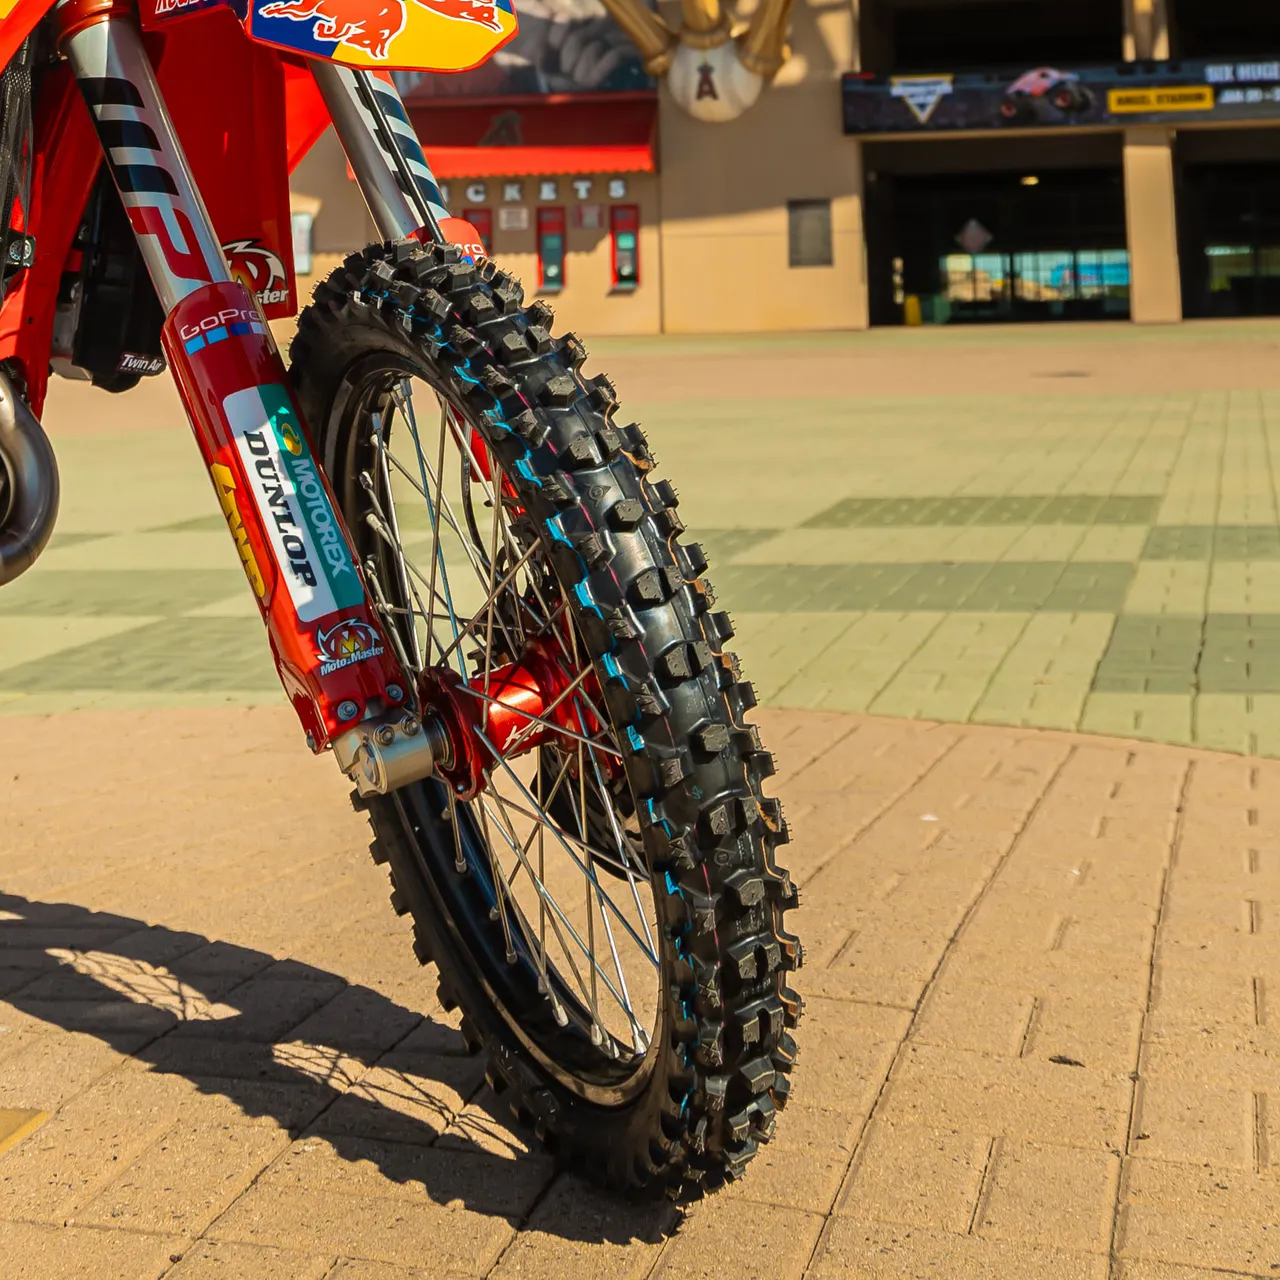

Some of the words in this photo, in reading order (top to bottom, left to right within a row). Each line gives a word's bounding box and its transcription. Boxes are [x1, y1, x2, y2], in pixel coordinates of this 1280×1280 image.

[442, 180, 627, 203] CKETS
[180, 308, 262, 341] GoPro
[122, 354, 149, 370] Twin
[243, 430, 318, 588] DUNLOP
[291, 458, 352, 579] MOTOREX
